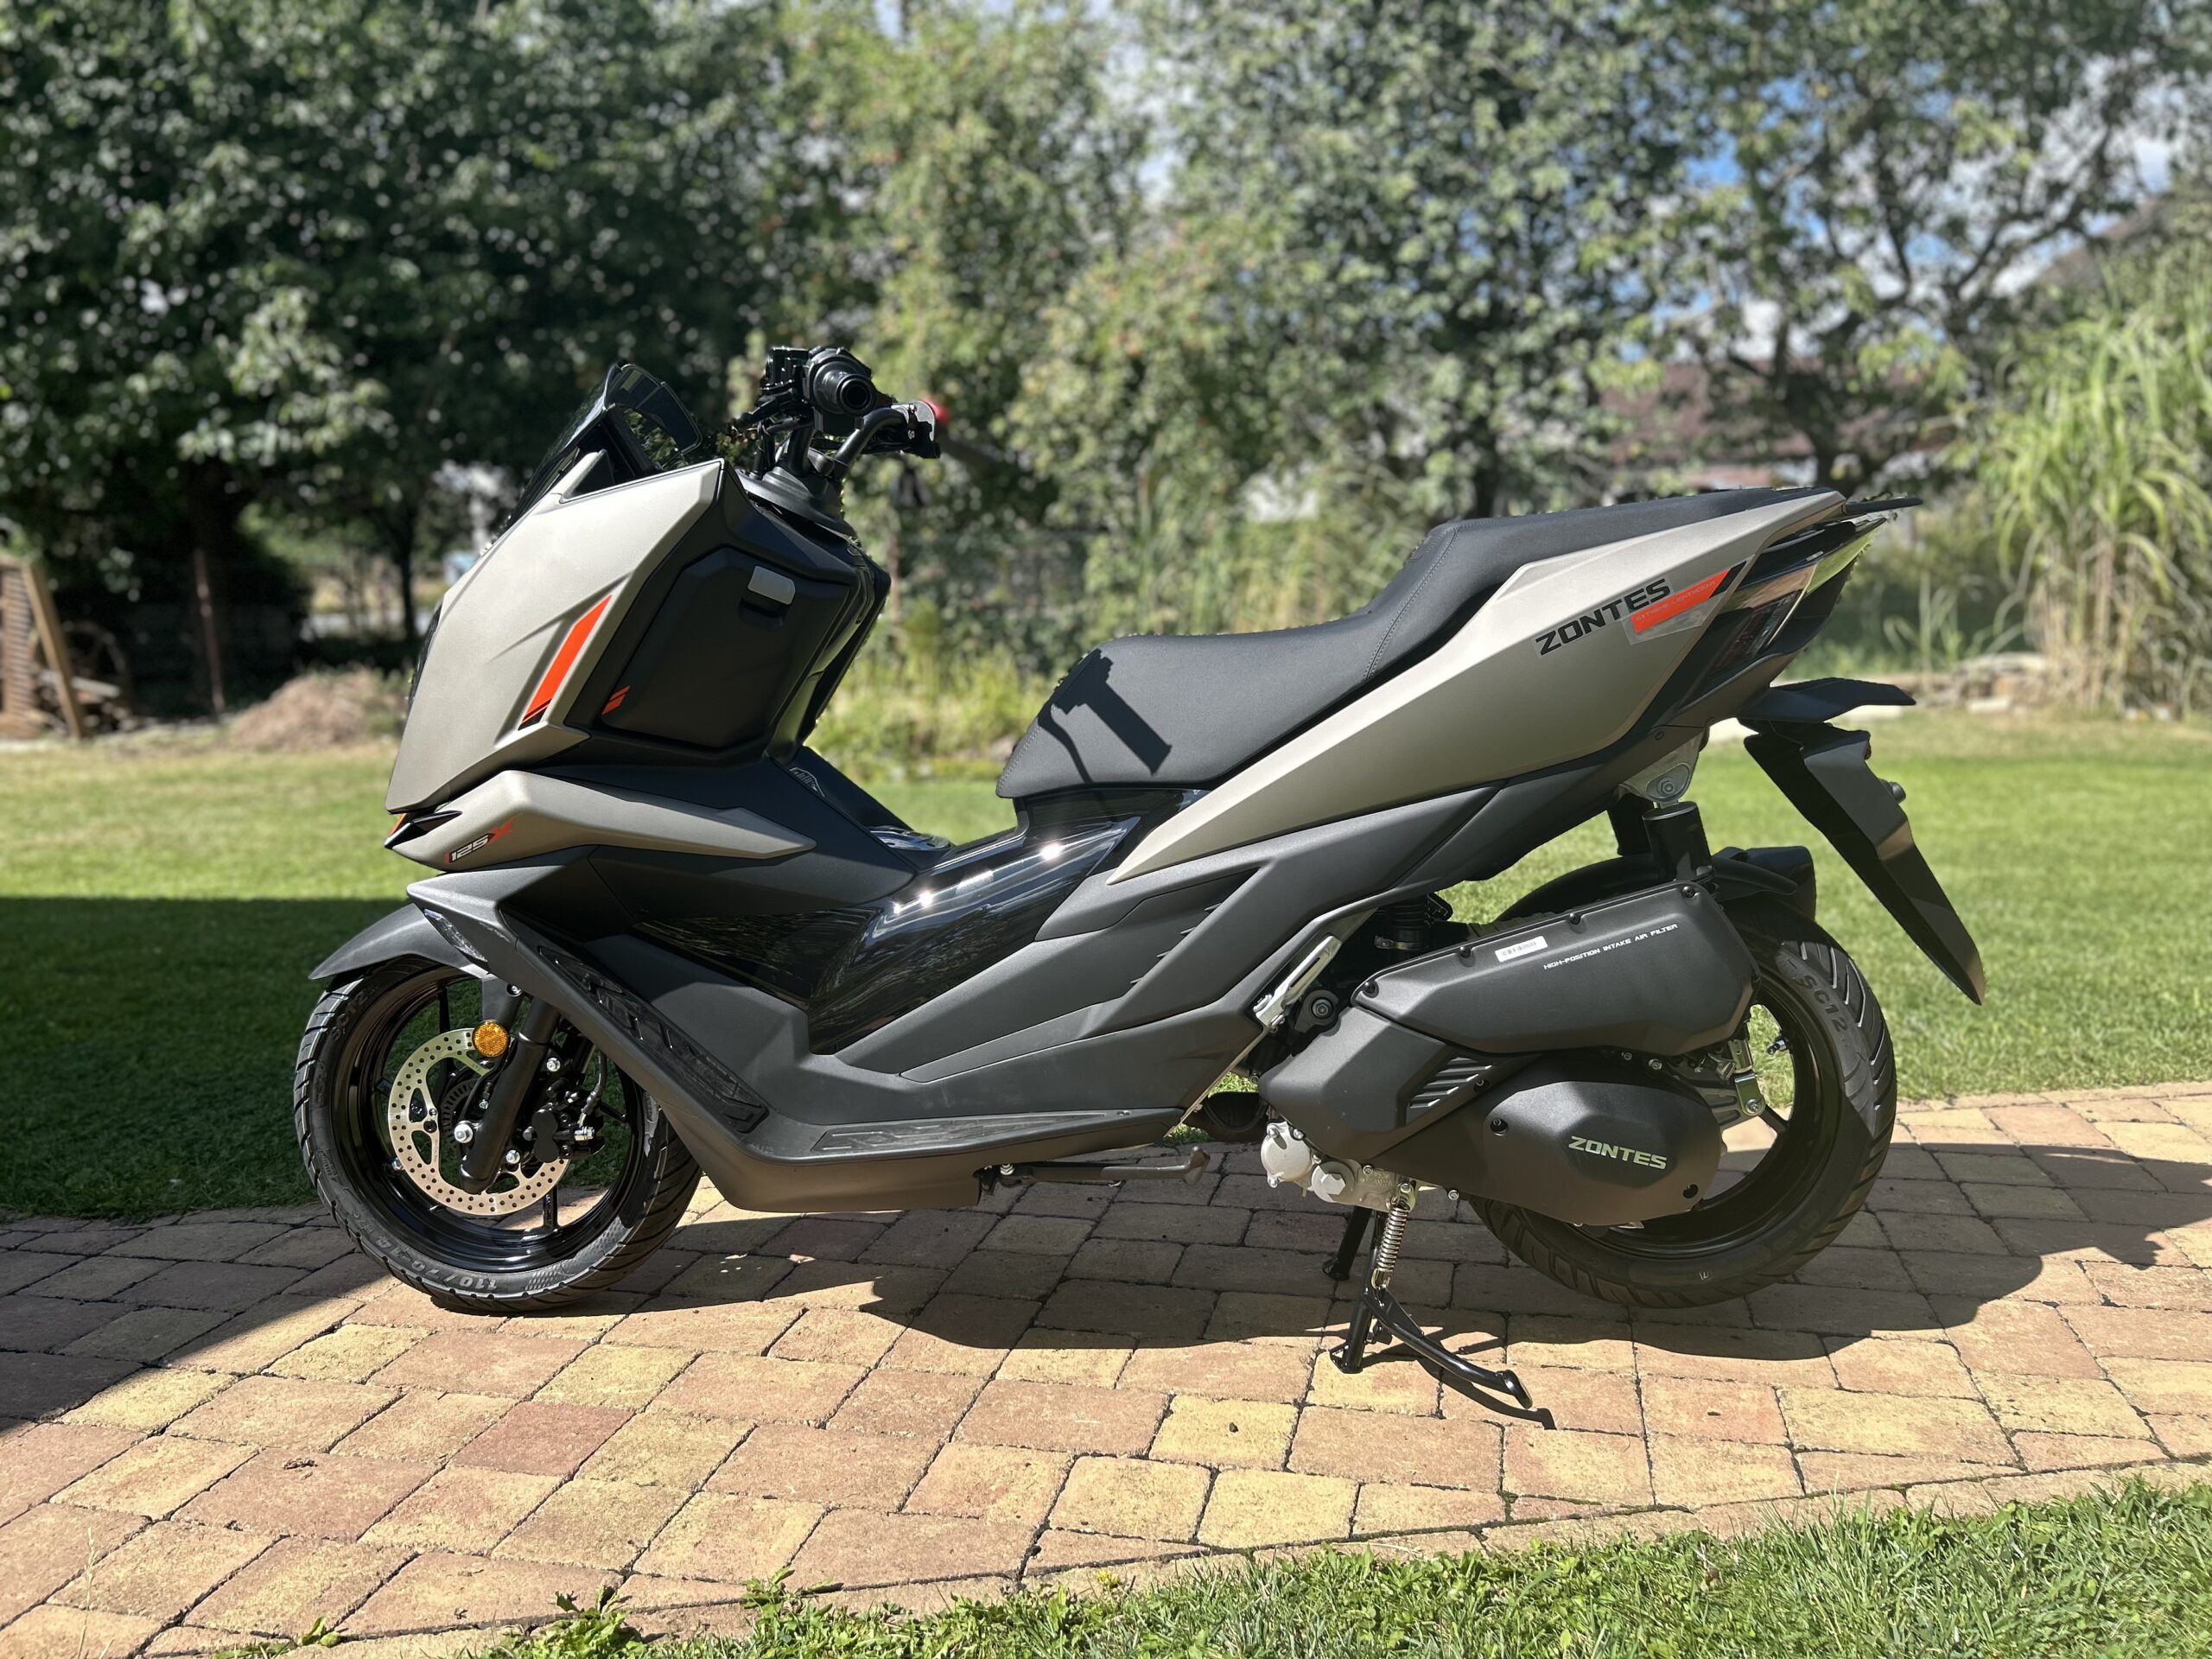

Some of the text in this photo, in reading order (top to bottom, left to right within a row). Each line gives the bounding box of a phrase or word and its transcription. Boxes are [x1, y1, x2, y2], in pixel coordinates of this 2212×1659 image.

[1535, 578, 1672, 657] ZONTES
[1543, 948, 1601, 970] HIGH-POSITION
[1602, 938, 1632, 952] INTAKE
[1634, 933, 1648, 943] AIR
[1649, 923, 1679, 938] FILTER
[1568, 1135, 1668, 1170] ZONTES
